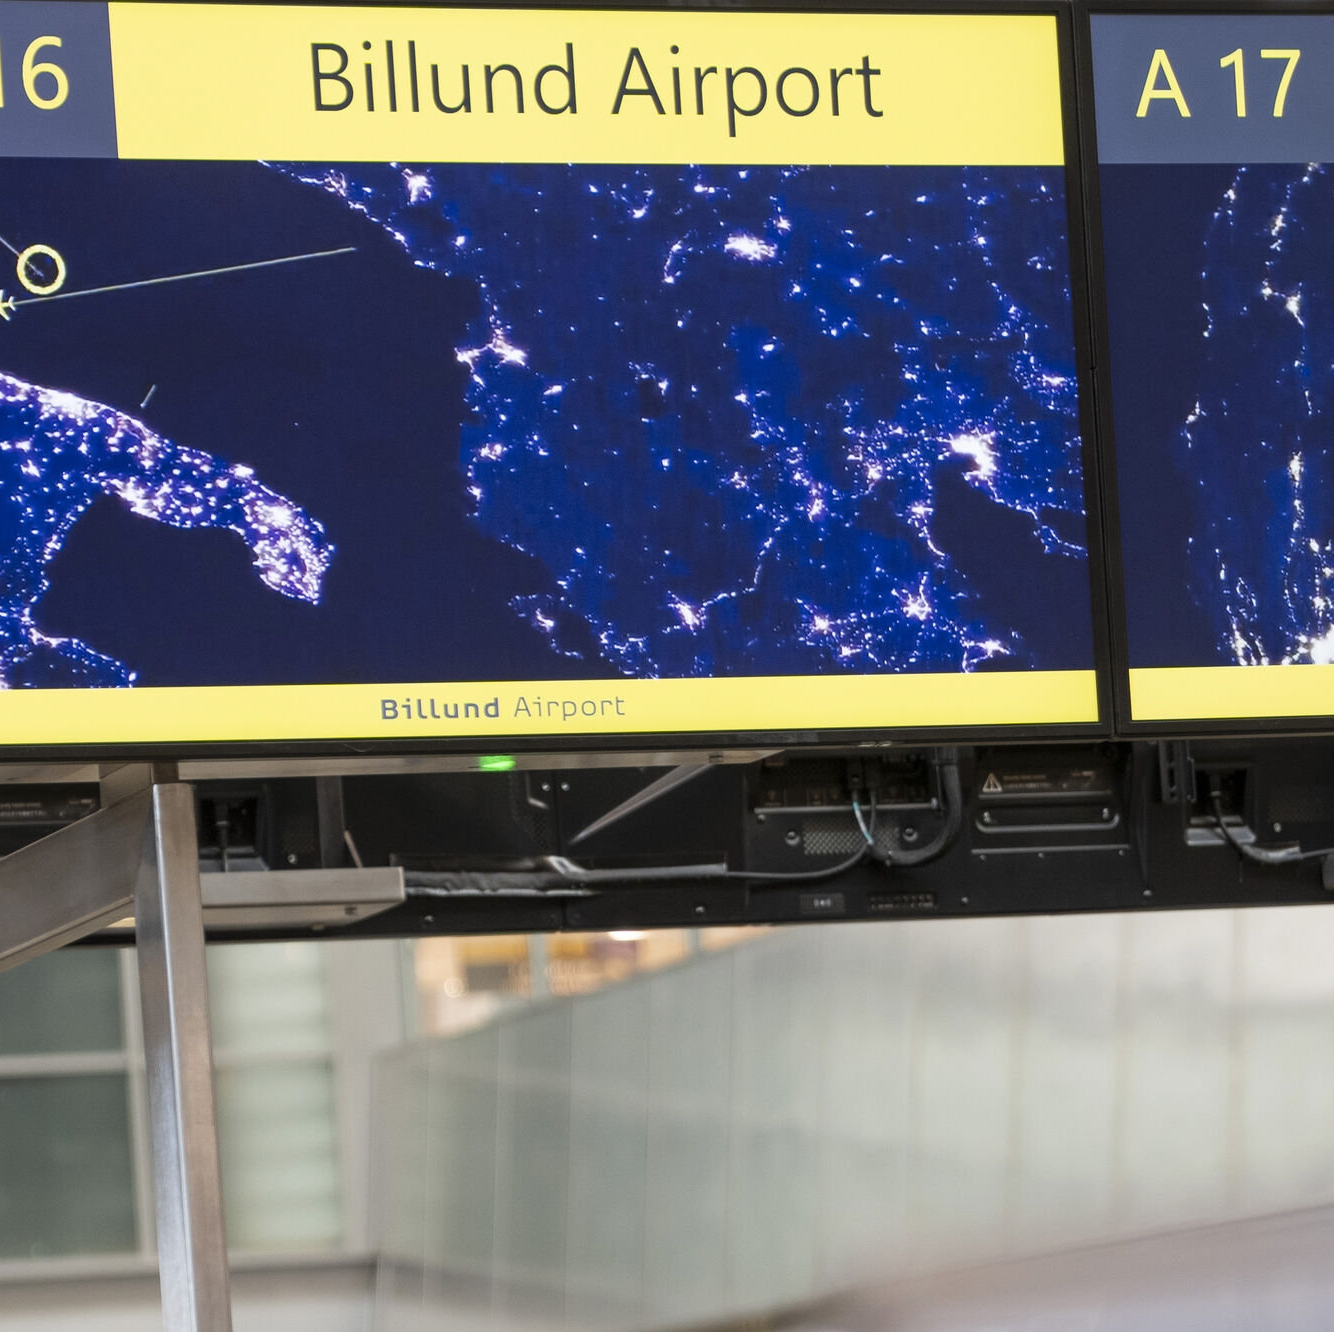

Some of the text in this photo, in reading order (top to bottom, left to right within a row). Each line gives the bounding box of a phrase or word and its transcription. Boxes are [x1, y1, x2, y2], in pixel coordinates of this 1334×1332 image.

[311, 39, 884, 137] Billund Airport
[1136, 48, 1301, 118] A 17
[380, 695, 626, 722] Billund Airport
